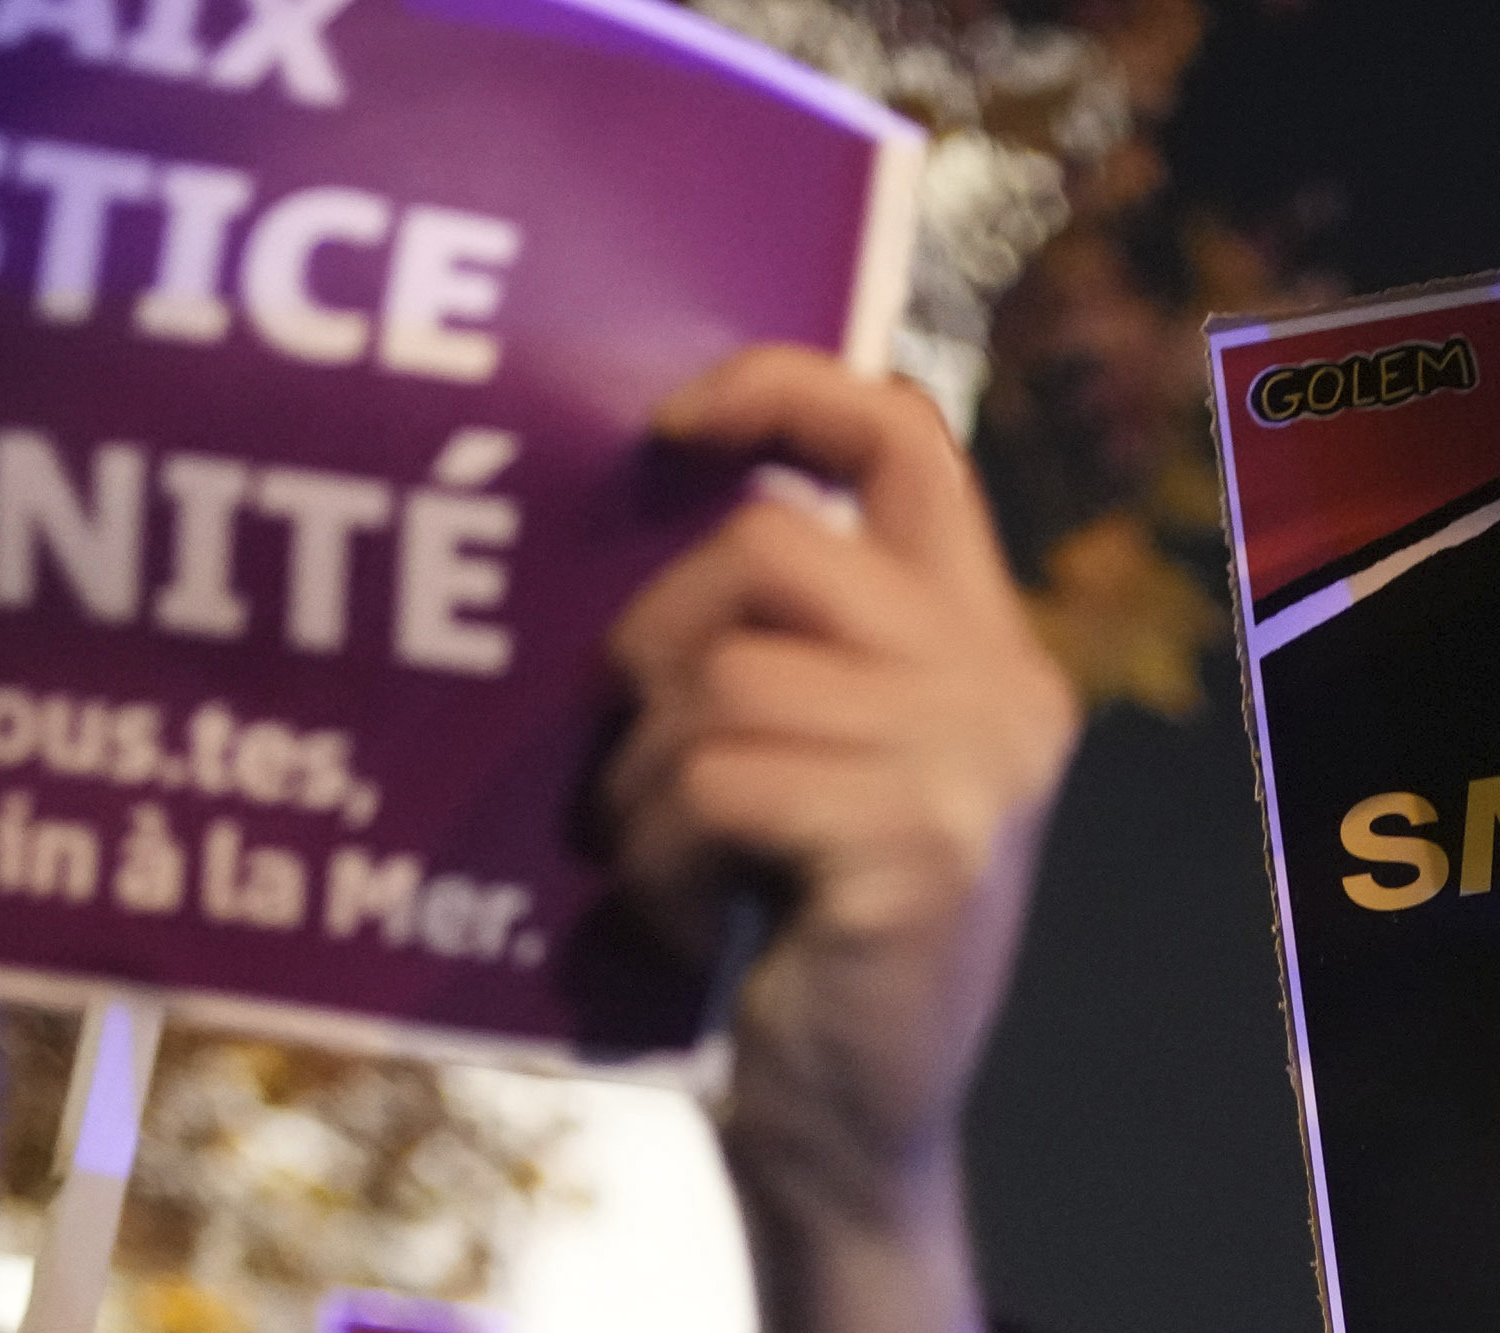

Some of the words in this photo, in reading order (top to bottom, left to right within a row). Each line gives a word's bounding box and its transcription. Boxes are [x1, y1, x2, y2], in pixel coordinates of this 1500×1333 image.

[1257, 338, 1472, 424] GOLEM
[112, 801, 186, 915] à
[200, 818, 306, 931] la
[321, 846, 548, 970] Mer.
